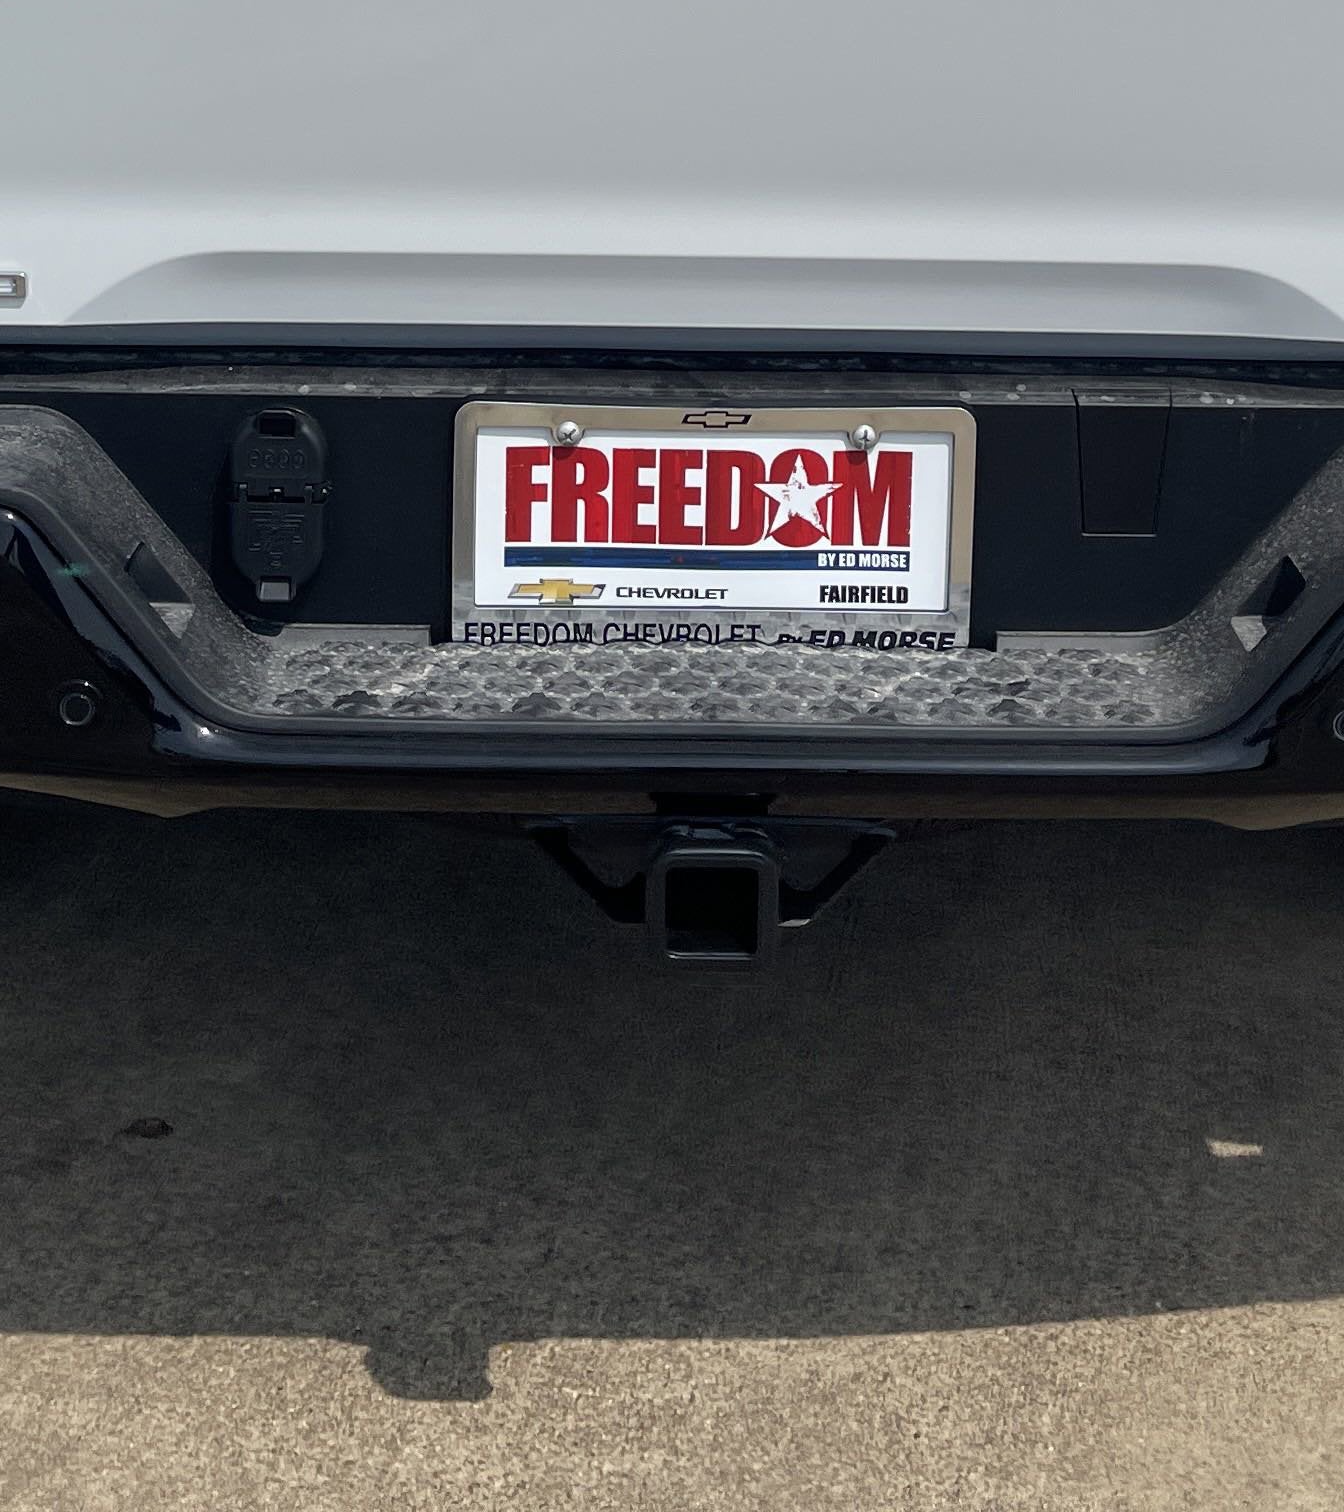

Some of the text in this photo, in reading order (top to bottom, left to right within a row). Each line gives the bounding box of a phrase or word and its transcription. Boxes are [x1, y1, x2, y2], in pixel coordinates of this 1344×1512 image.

[504, 446, 913, 548] FREEDOM
[817, 553, 907, 568] BY ED MORSE
[615, 587, 728, 600] CHEVROLET
[819, 585, 909, 604] FAIRFIELD
[464, 622, 593, 646] FREEDOM
[809, 630, 846, 648] ED
[851, 630, 956, 651] MORSE
